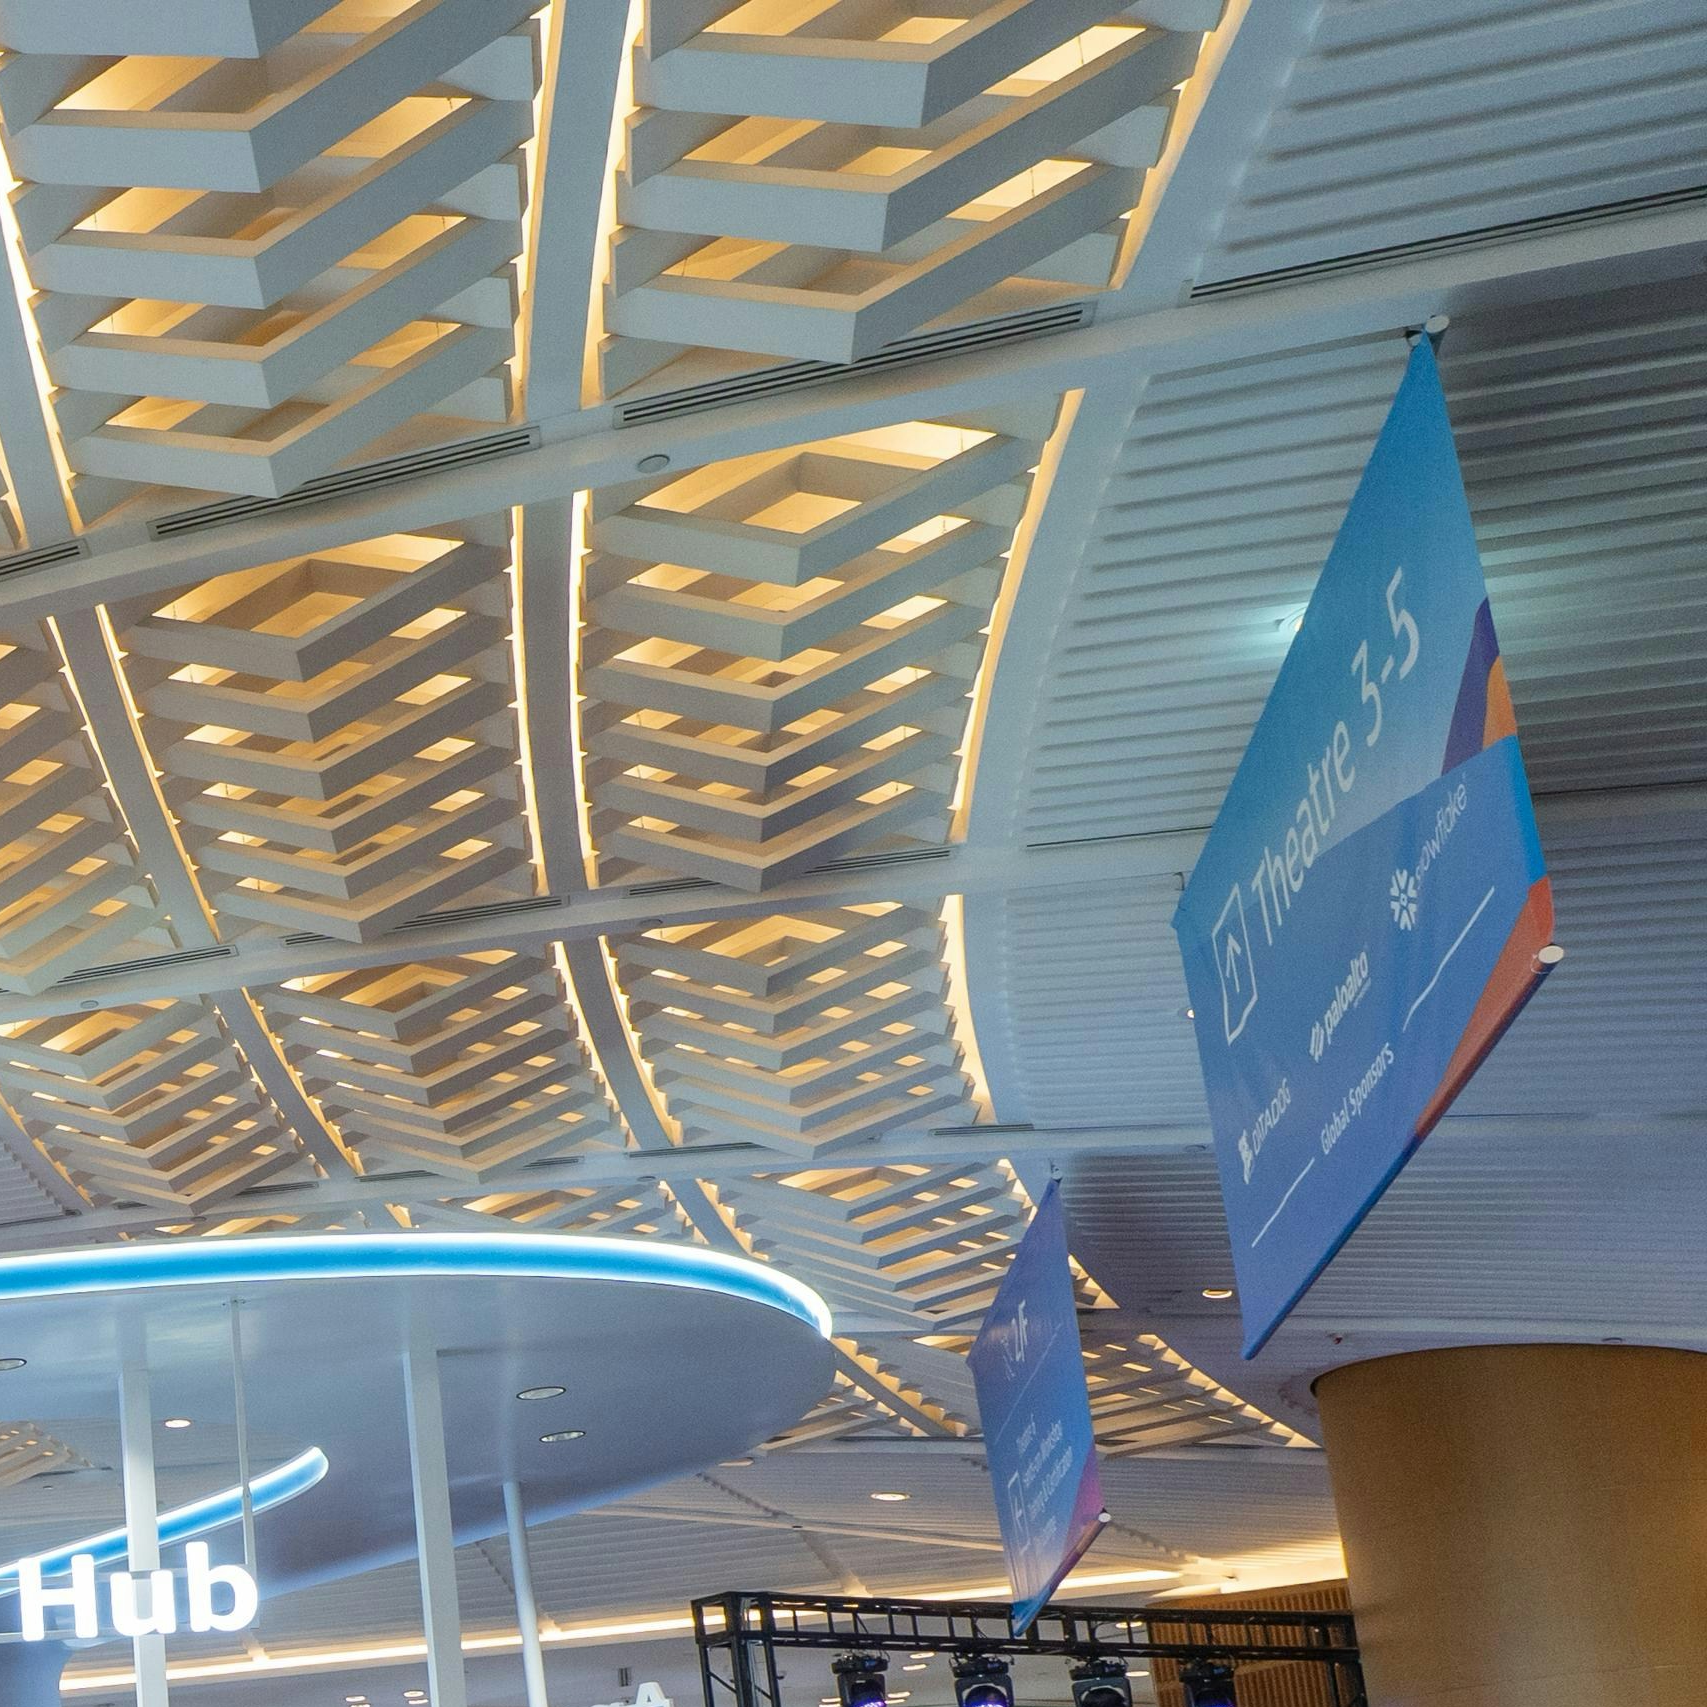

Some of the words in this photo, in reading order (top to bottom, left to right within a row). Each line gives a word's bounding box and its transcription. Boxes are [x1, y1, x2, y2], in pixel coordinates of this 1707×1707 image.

[1252, 721, 1355, 946] Theatre
[1351, 566, 1419, 747] 3-5
[1324, 950, 1369, 1047] paloalto
[1251, 1078, 1292, 1157] DATADOG
[1321, 1096, 1350, 1156] Global
[1348, 1042, 1395, 1118] Sponsors
[17, 1541, 259, 1643] Hub
